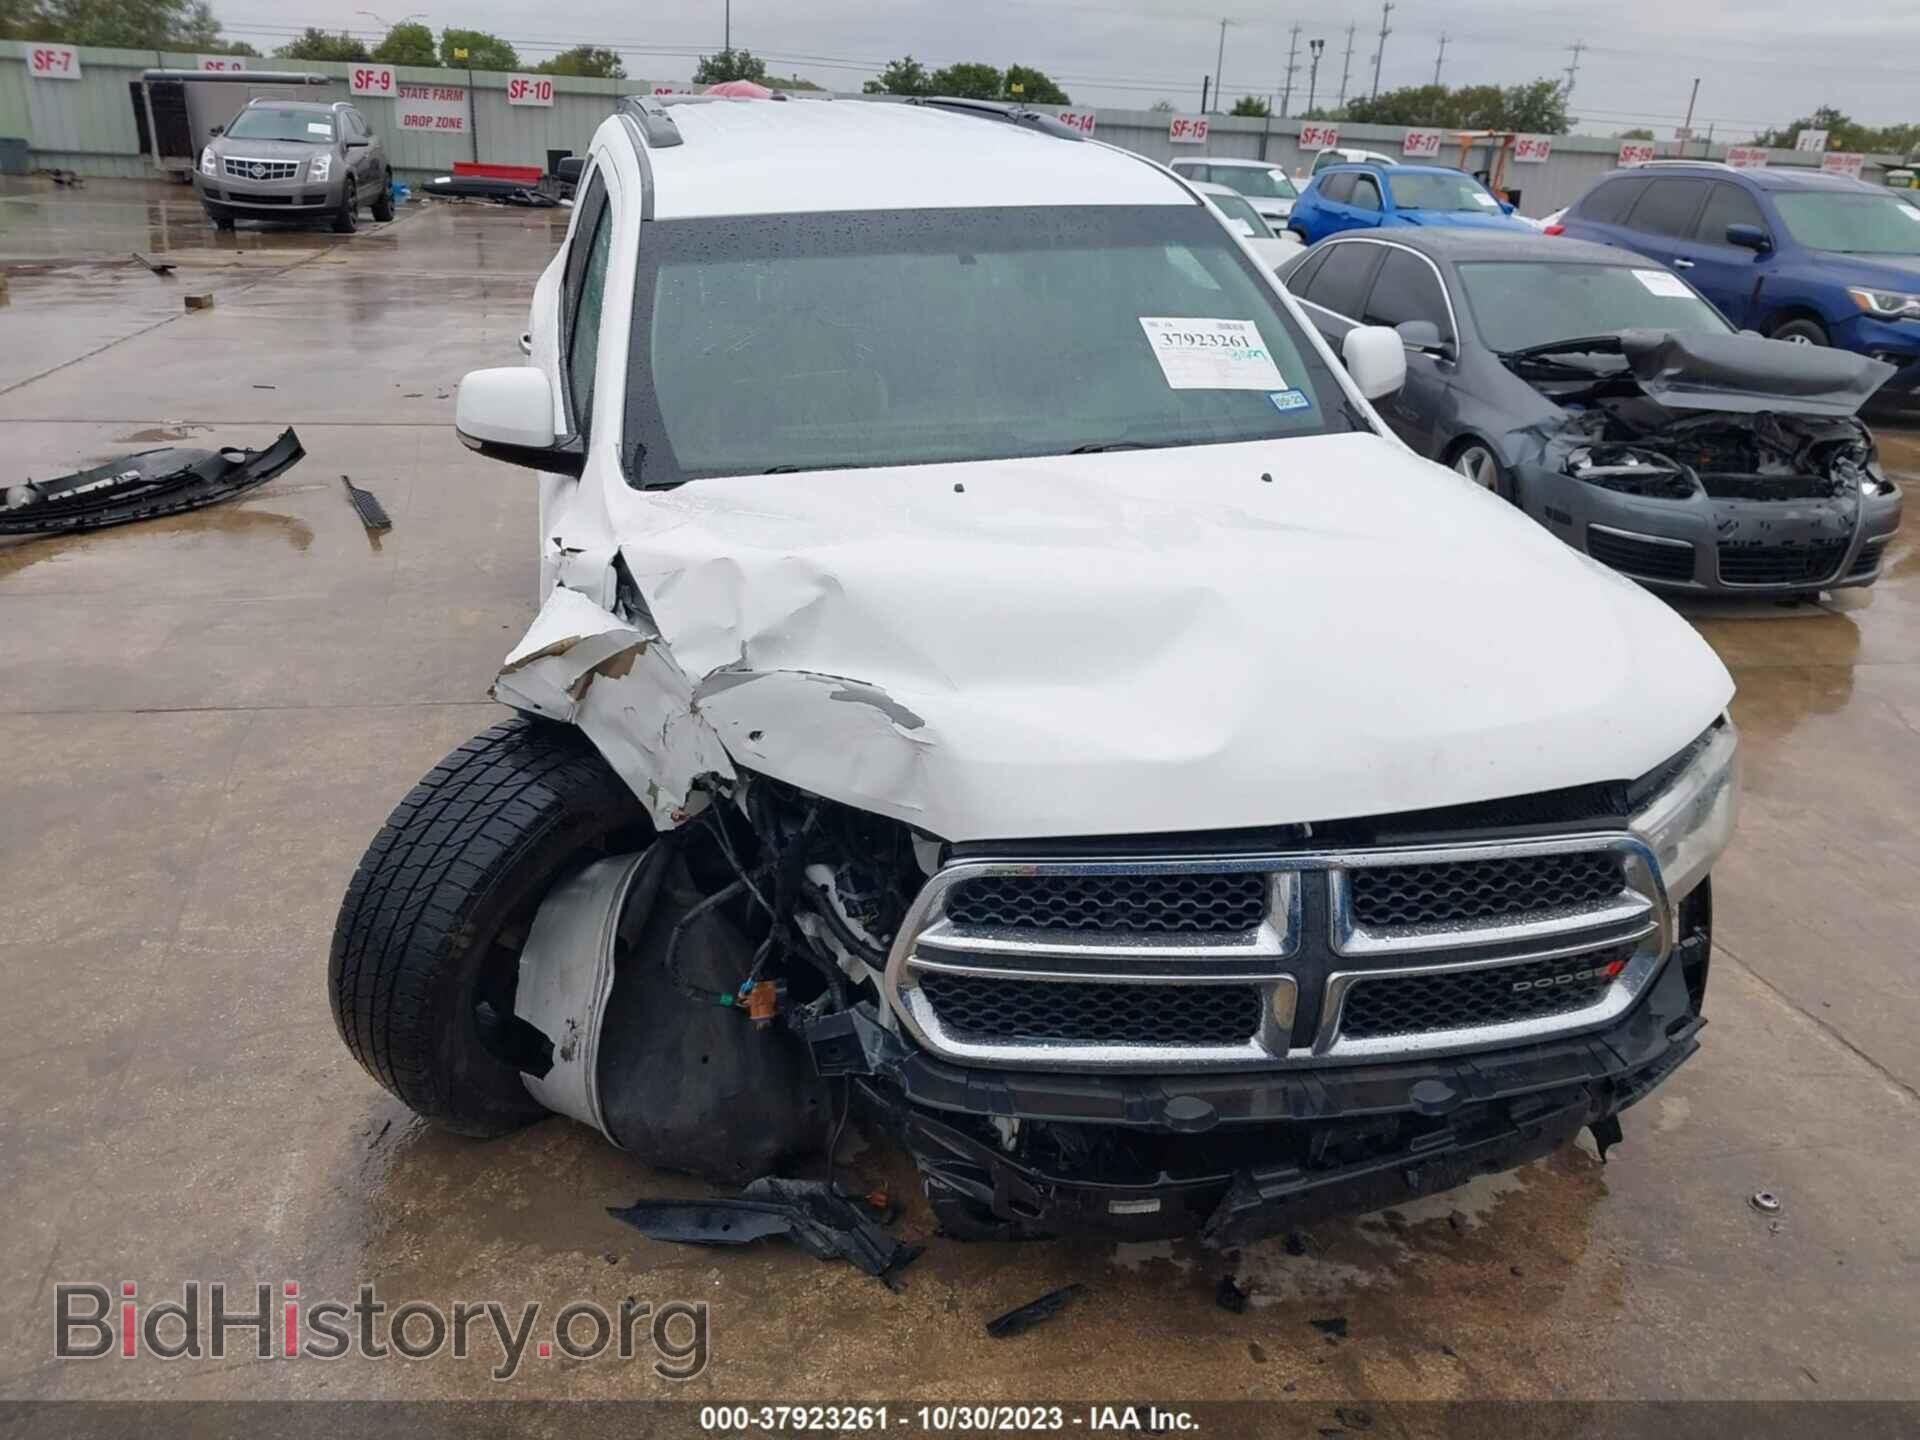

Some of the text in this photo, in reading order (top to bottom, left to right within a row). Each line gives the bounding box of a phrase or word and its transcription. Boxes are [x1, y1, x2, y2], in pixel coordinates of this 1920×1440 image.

[33, 49, 71, 71] SF-7
[354, 69, 390, 91] SF-9
[509, 79, 552, 101] SF-10
[399, 86, 463, 102] STATE FARM
[404, 114, 463, 130] DROP ZONE
[1170, 119, 1208, 139] SF-15
[1300, 127, 1336, 147] SF-16
[1404, 133, 1440, 151] SF-17
[1161, 332, 1251, 348] 37923261
[1512, 967, 1613, 992] DODGE
